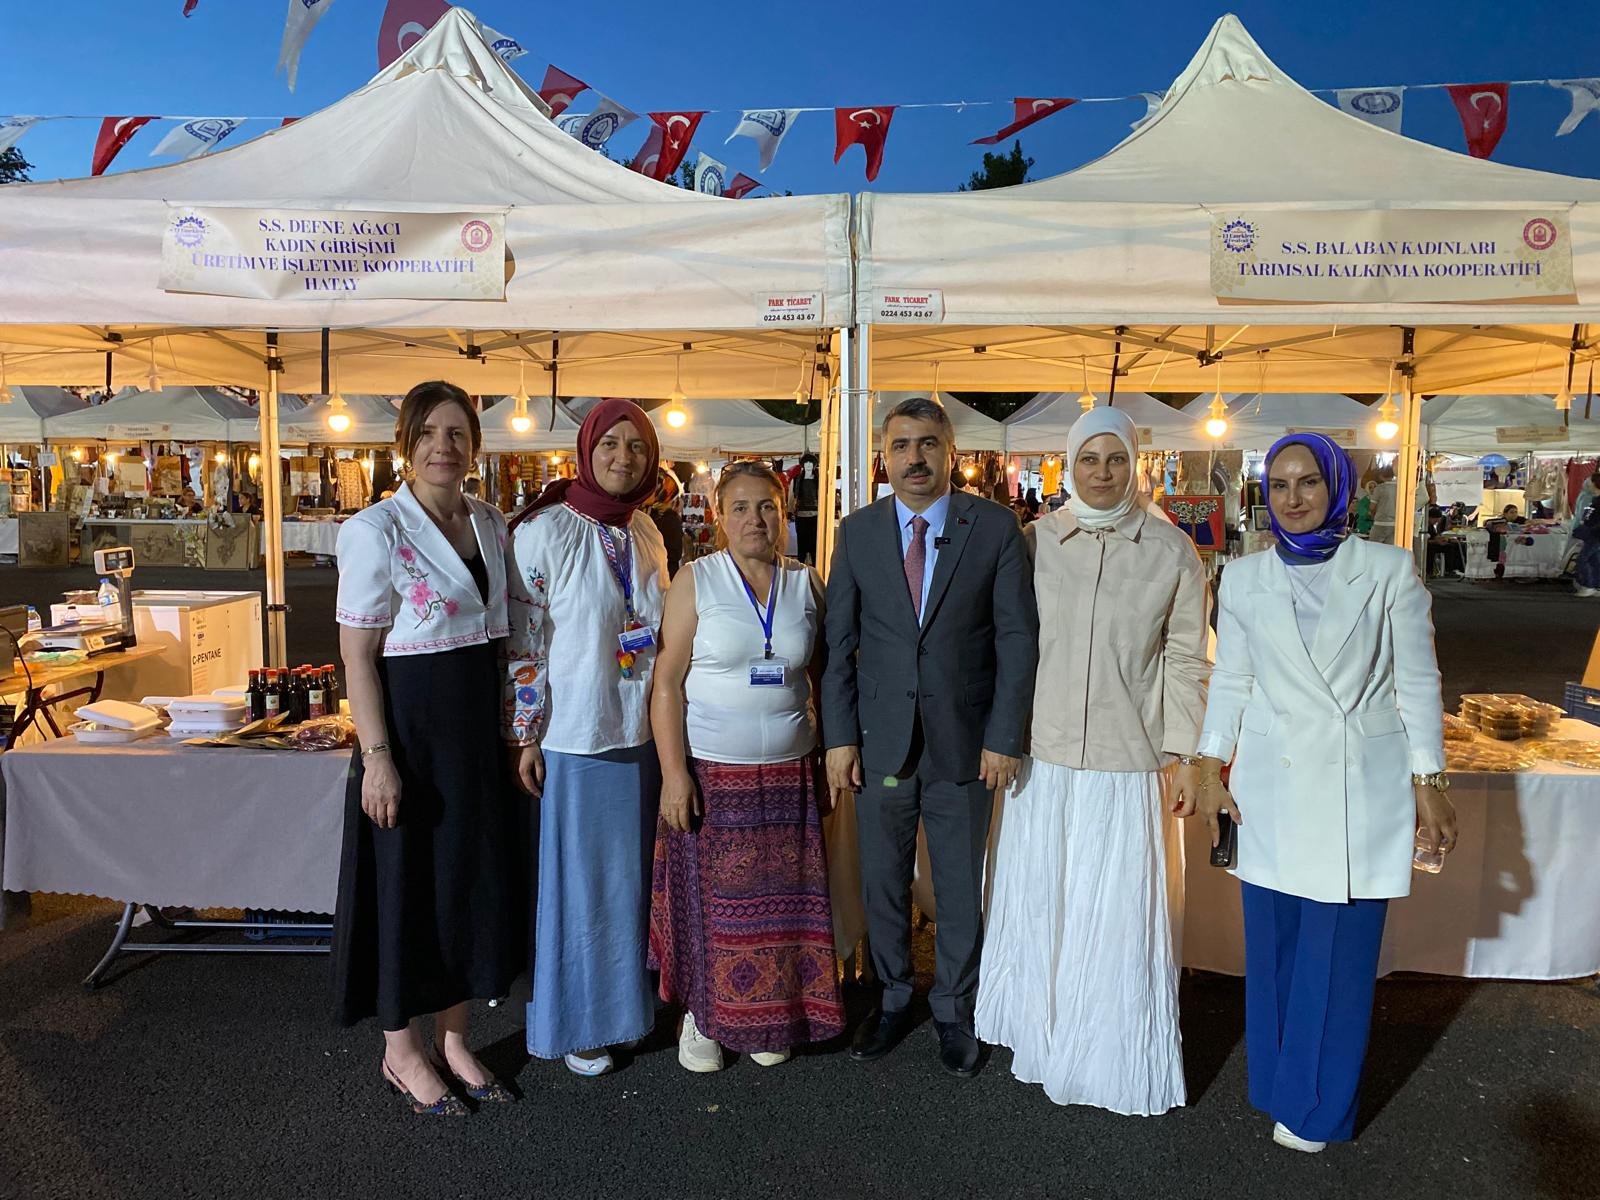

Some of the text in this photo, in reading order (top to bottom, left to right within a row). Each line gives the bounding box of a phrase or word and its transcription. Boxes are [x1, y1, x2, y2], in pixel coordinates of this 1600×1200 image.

[258, 219, 400, 236] S.S. DEFNE AĞACI
[266, 238, 396, 257] KADIN GİRİŞİMİ
[1281, 241, 1496, 255] S.S. BALABAN KADINLARI
[258, 257, 278, 270] VE
[282, 255, 359, 274] İŞLETME
[363, 257, 474, 273] KOOPERATİFİ
[1237, 259, 1542, 277] TARIMSAL KALKINMA KOOPERATİFİ
[304, 277, 359, 291] HATAY
[768, 298, 784, 307] PARK
[884, 295, 900, 303] PARK
[796, 313, 805, 321] 43
[192, 647, 222, 665] C-PENTANE
